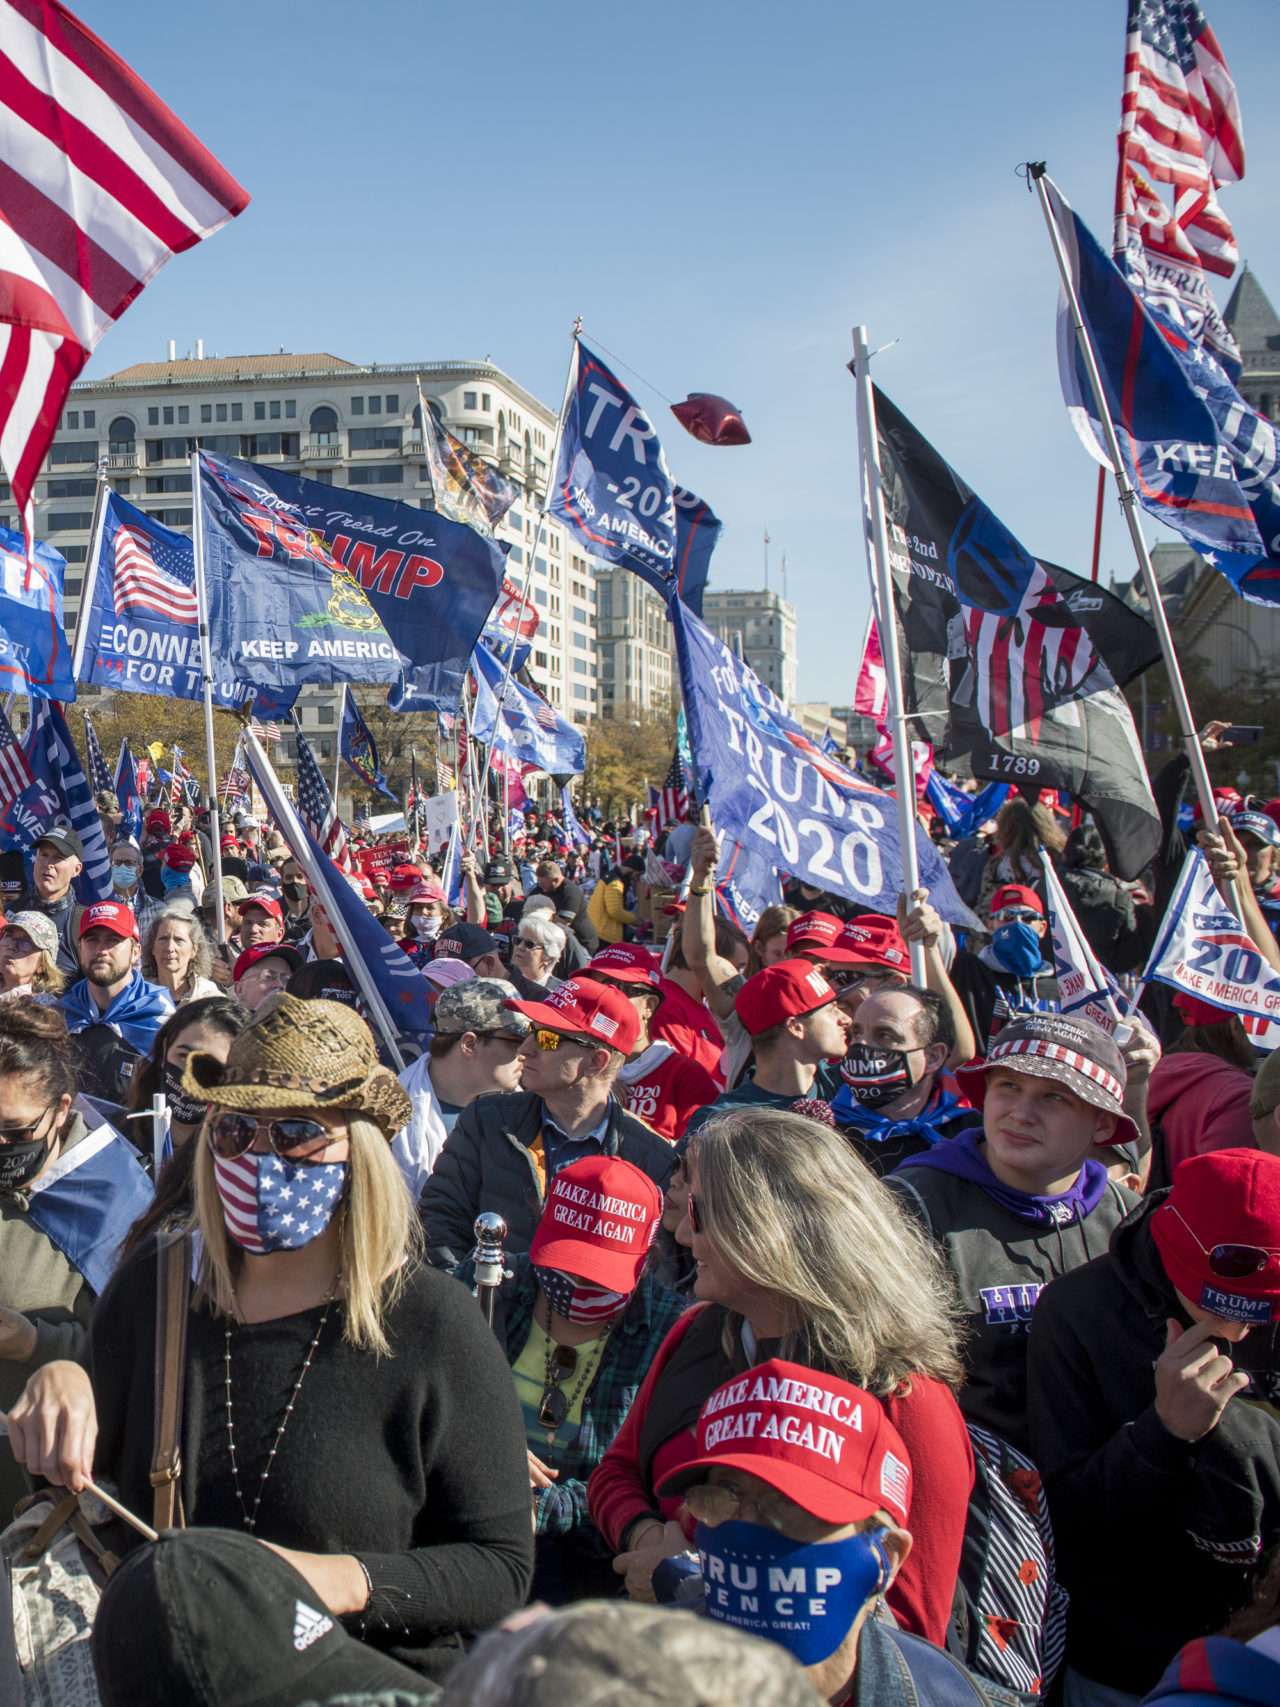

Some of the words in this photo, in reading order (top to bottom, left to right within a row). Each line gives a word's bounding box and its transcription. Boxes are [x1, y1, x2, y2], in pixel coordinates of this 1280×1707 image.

[1152, 443, 1238, 482] KEE
[240, 512, 446, 600] TRUMP
[399, 530, 437, 549] On
[240, 640, 299, 660] KEEP
[308, 640, 400, 662] AMERIC
[125, 658, 175, 687] FOR
[988, 752, 1042, 778] 1789
[746, 774, 884, 898] 2020
[1206, 981, 1259, 1006] AMERICA
[552, 1179, 589, 1207] MAKE
[585, 1187, 648, 1223] AMERICA
[552, 1204, 594, 1233] GREAT
[592, 1214, 636, 1245] AGAIN
[1205, 1286, 1272, 1312] TRUMP
[703, 1376, 750, 1420] MAKE
[751, 1376, 864, 1434] AMERICA
[704, 1411, 761, 1451] GREAT
[759, 1413, 846, 1465] AGAIN
[292, 1615, 336, 1653] adidas
[725, 1614, 769, 1629] AMERICA
[771, 1620, 812, 1632] GREAT!
